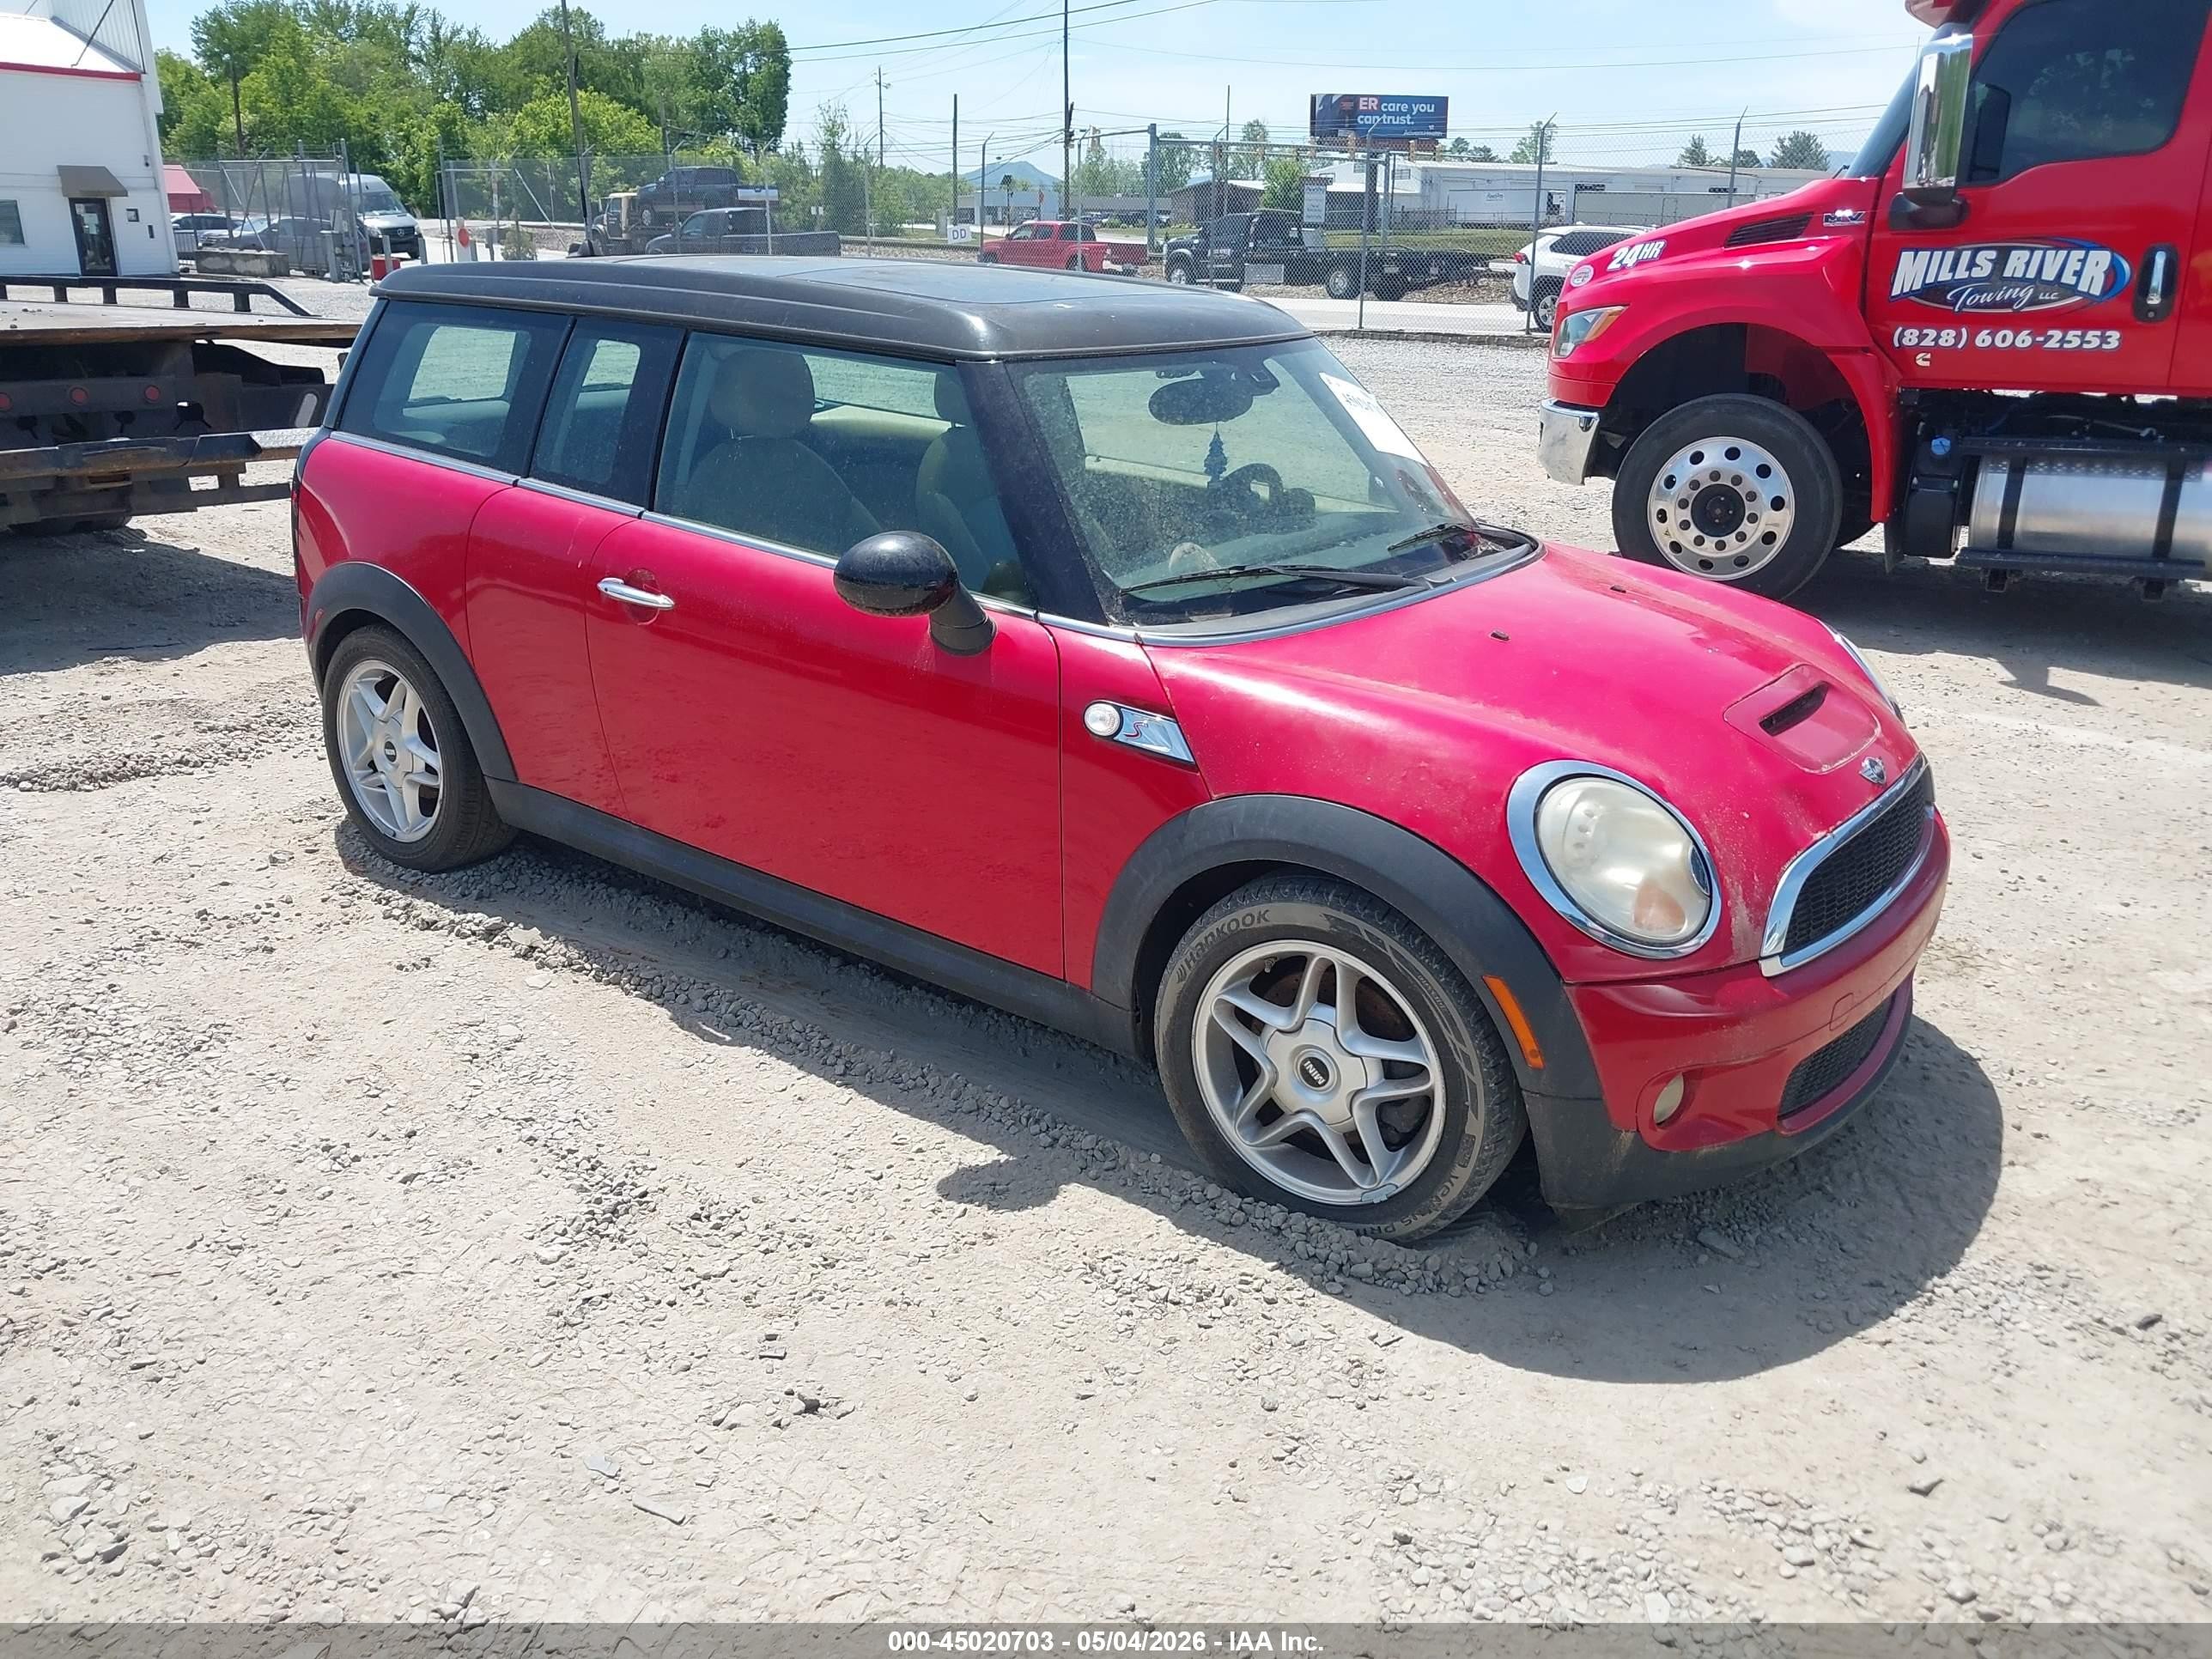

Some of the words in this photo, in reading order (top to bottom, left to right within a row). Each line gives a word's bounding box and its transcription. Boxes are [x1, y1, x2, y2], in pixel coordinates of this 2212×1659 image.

[1359, 97, 1378, 111] ER
[1381, 102, 1409, 112] care
[1412, 103, 1435, 115] you
[1357, 114, 1381, 125] can
[1382, 112, 1415, 125] trust.
[952, 228, 967, 240] DD
[1891, 250, 1998, 297] MILLS
[2002, 250, 2112, 296] RIVER
[1946, 283, 2035, 313] Towing
[1893, 327, 1969, 349] (828)
[1975, 330, 2122, 349] 606-2553
[1304, 1060, 1327, 1085] MINI
